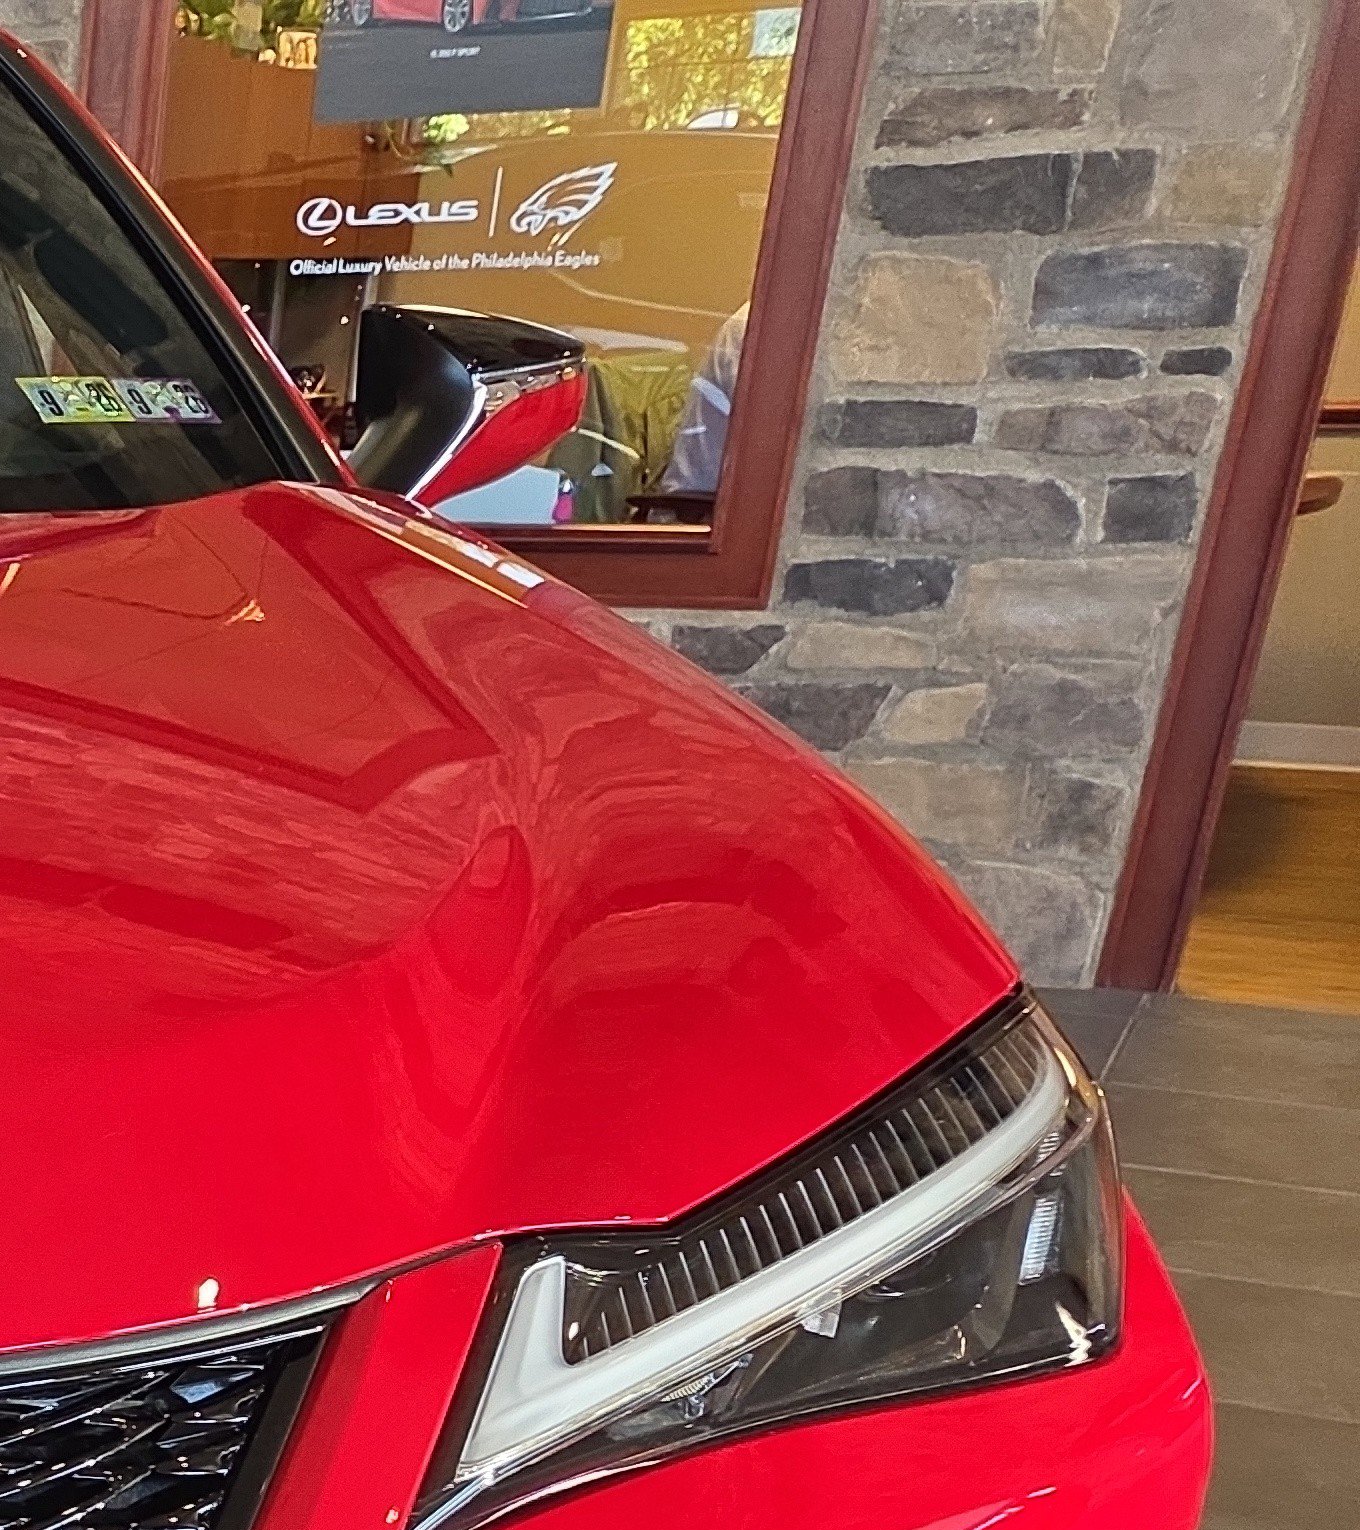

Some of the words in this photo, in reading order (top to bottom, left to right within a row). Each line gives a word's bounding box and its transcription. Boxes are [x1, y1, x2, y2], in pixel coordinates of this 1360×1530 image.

[345, 199, 479, 227] LEXUS
[289, 257, 338, 276] Official
[338, 257, 383, 276] Luxury
[384, 254, 432, 272] Vehicle
[432, 252, 448, 271] of
[448, 252, 470, 270] the
[471, 250, 553, 271] Philadelphia
[553, 249, 601, 269] Eagles
[37, 389, 65, 417] 9
[126, 388, 153, 415] 9
